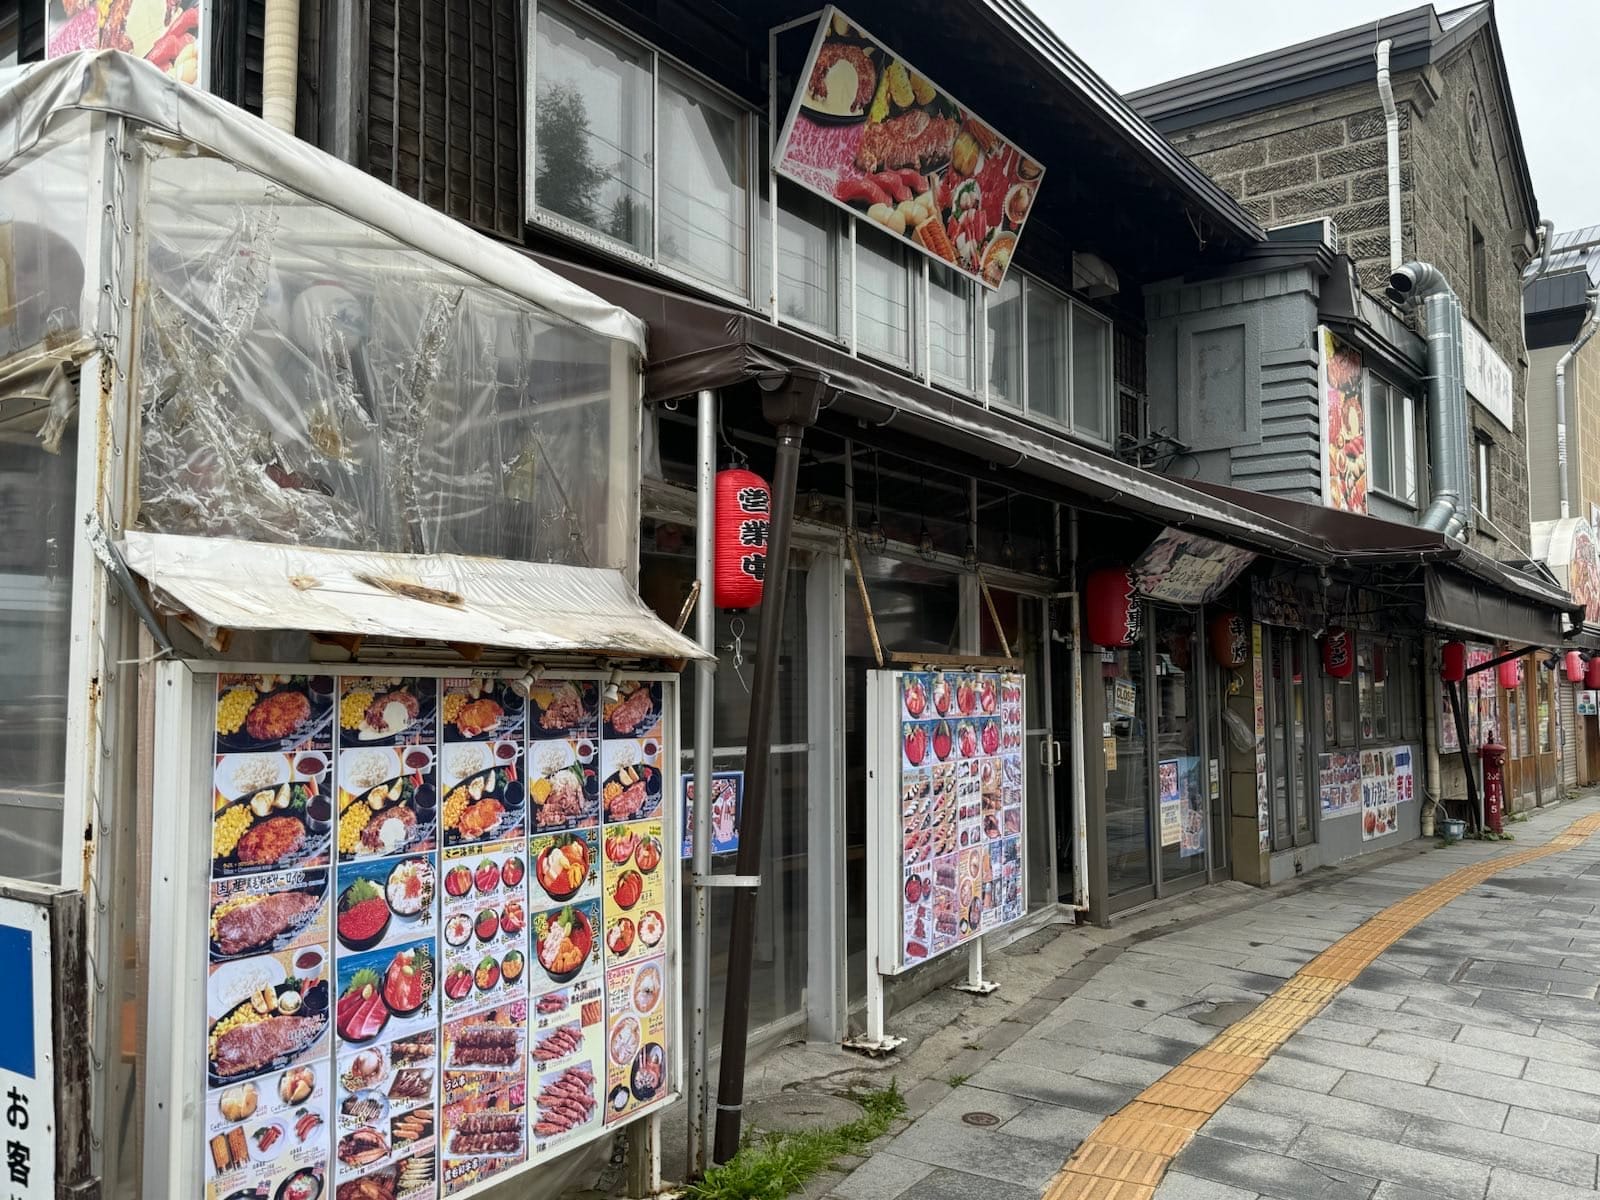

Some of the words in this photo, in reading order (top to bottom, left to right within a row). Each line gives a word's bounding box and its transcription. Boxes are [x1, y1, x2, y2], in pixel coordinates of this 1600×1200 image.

[586, 829, 598, 886] 北前丼
[6, 1085, 31, 1200] お客
